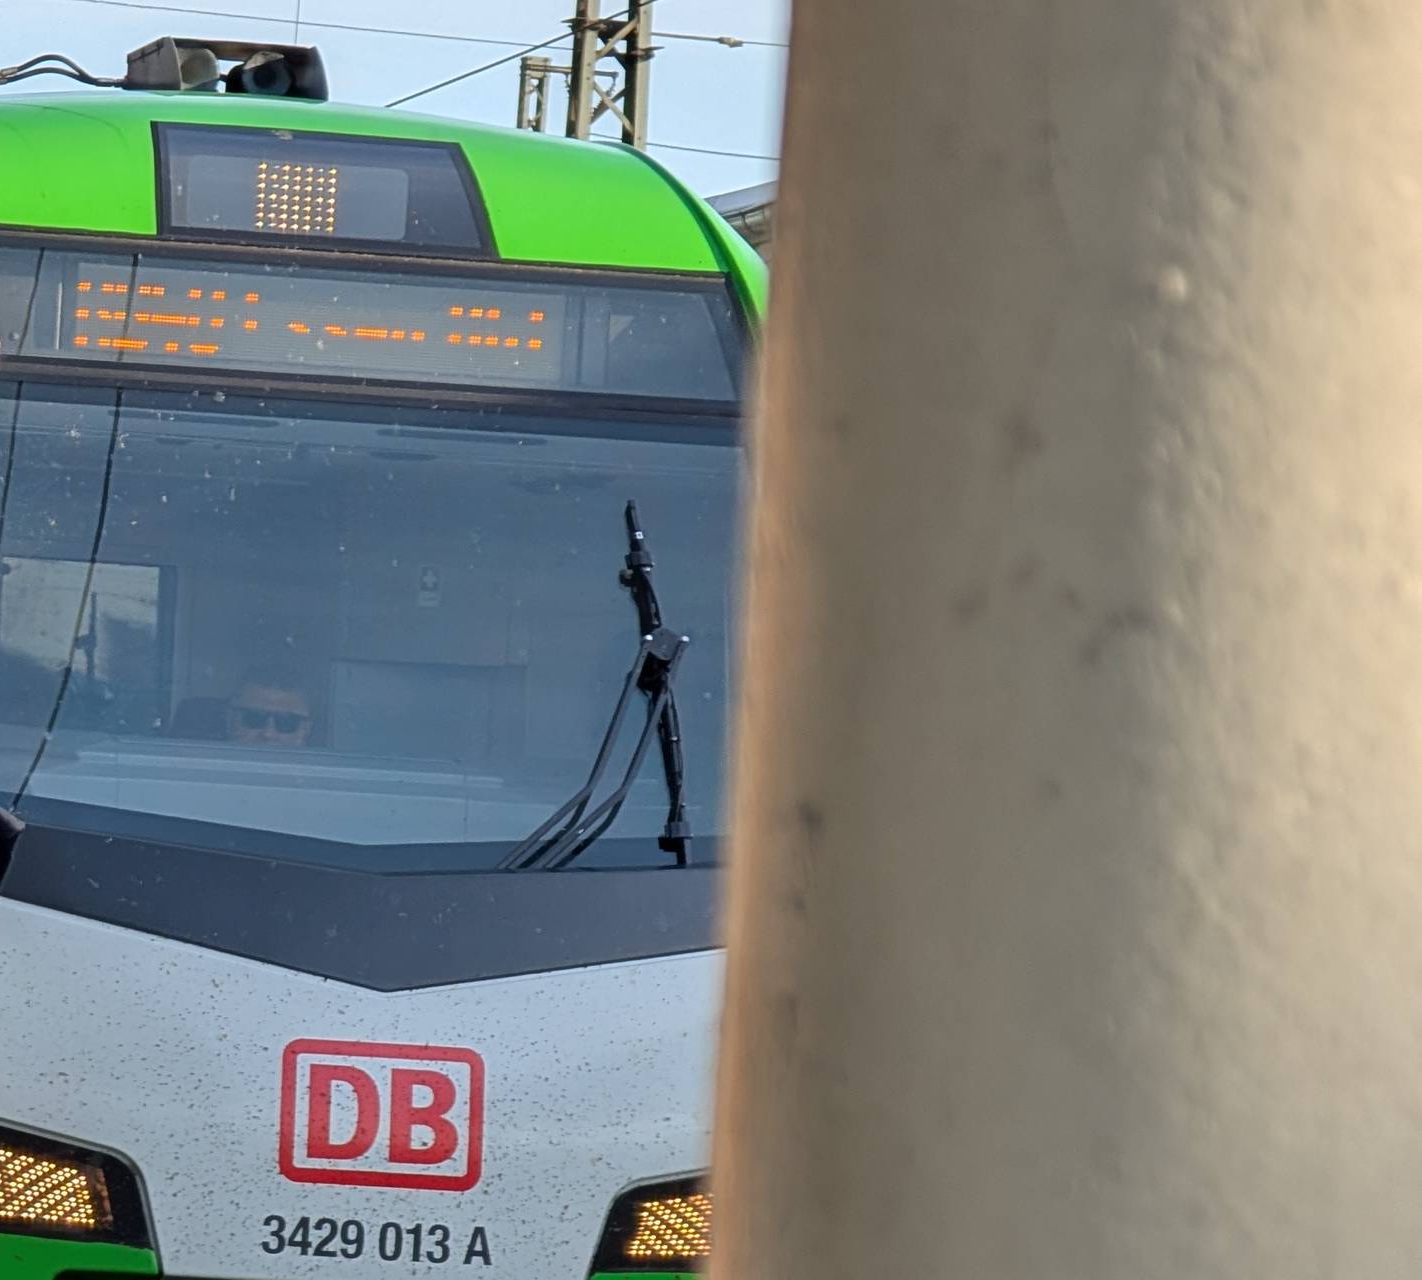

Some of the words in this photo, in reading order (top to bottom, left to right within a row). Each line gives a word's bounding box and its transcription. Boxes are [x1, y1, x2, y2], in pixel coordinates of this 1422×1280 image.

[305, 1062, 460, 1165] DB
[260, 1214, 365, 1259] 3429
[378, 1221, 451, 1264] 013
[463, 1226, 493, 1266] A
